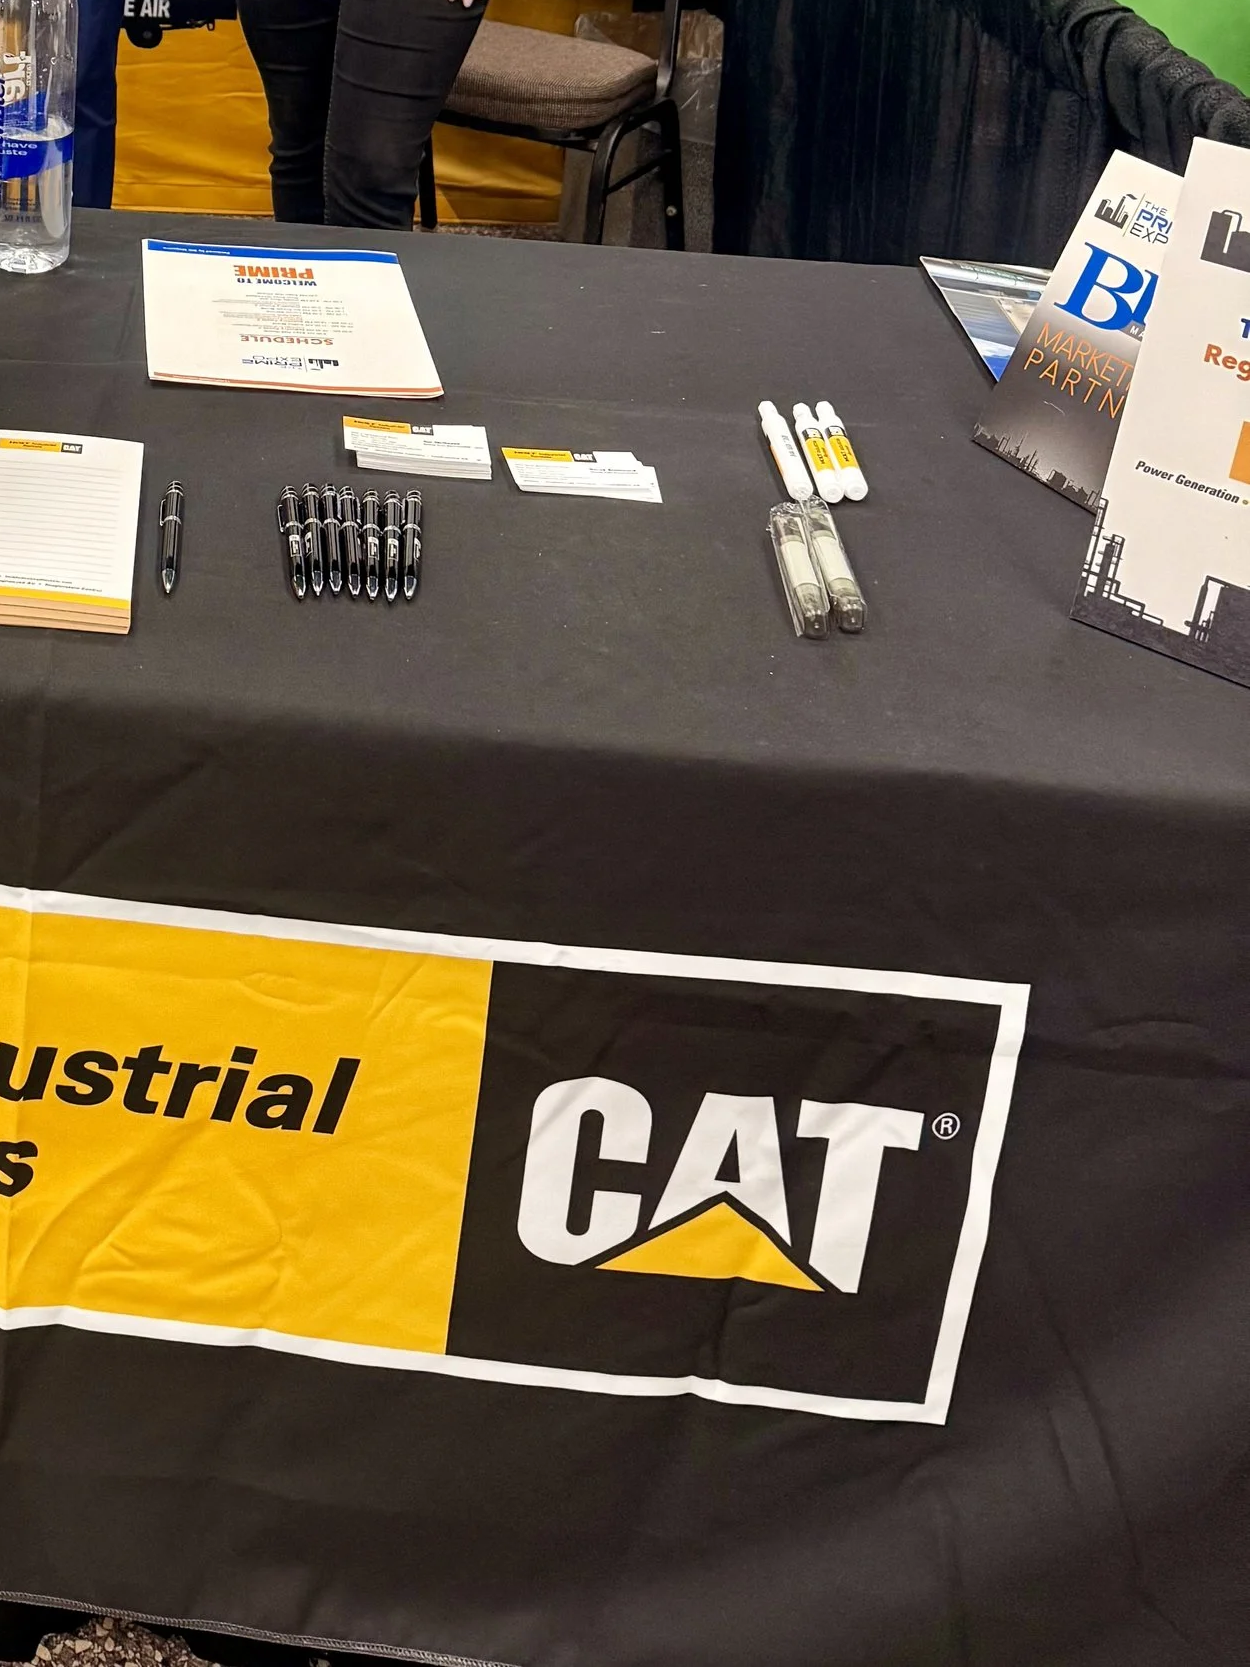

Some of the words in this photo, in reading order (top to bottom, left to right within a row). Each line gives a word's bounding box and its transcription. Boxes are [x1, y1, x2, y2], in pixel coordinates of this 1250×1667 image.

[1145, 200, 1168, 216] THE
[233, 264, 314, 280] PRIME
[255, 277, 317, 287] WELCOME
[240, 334, 334, 346] SCHEDULE
[1023, 347, 1126, 419] PARTN
[63, 444, 81, 452] CAT
[1134, 459, 1175, 482] Power
[1174, 473, 1241, 505] Generation
[516, 1075, 925, 1295] CAT
